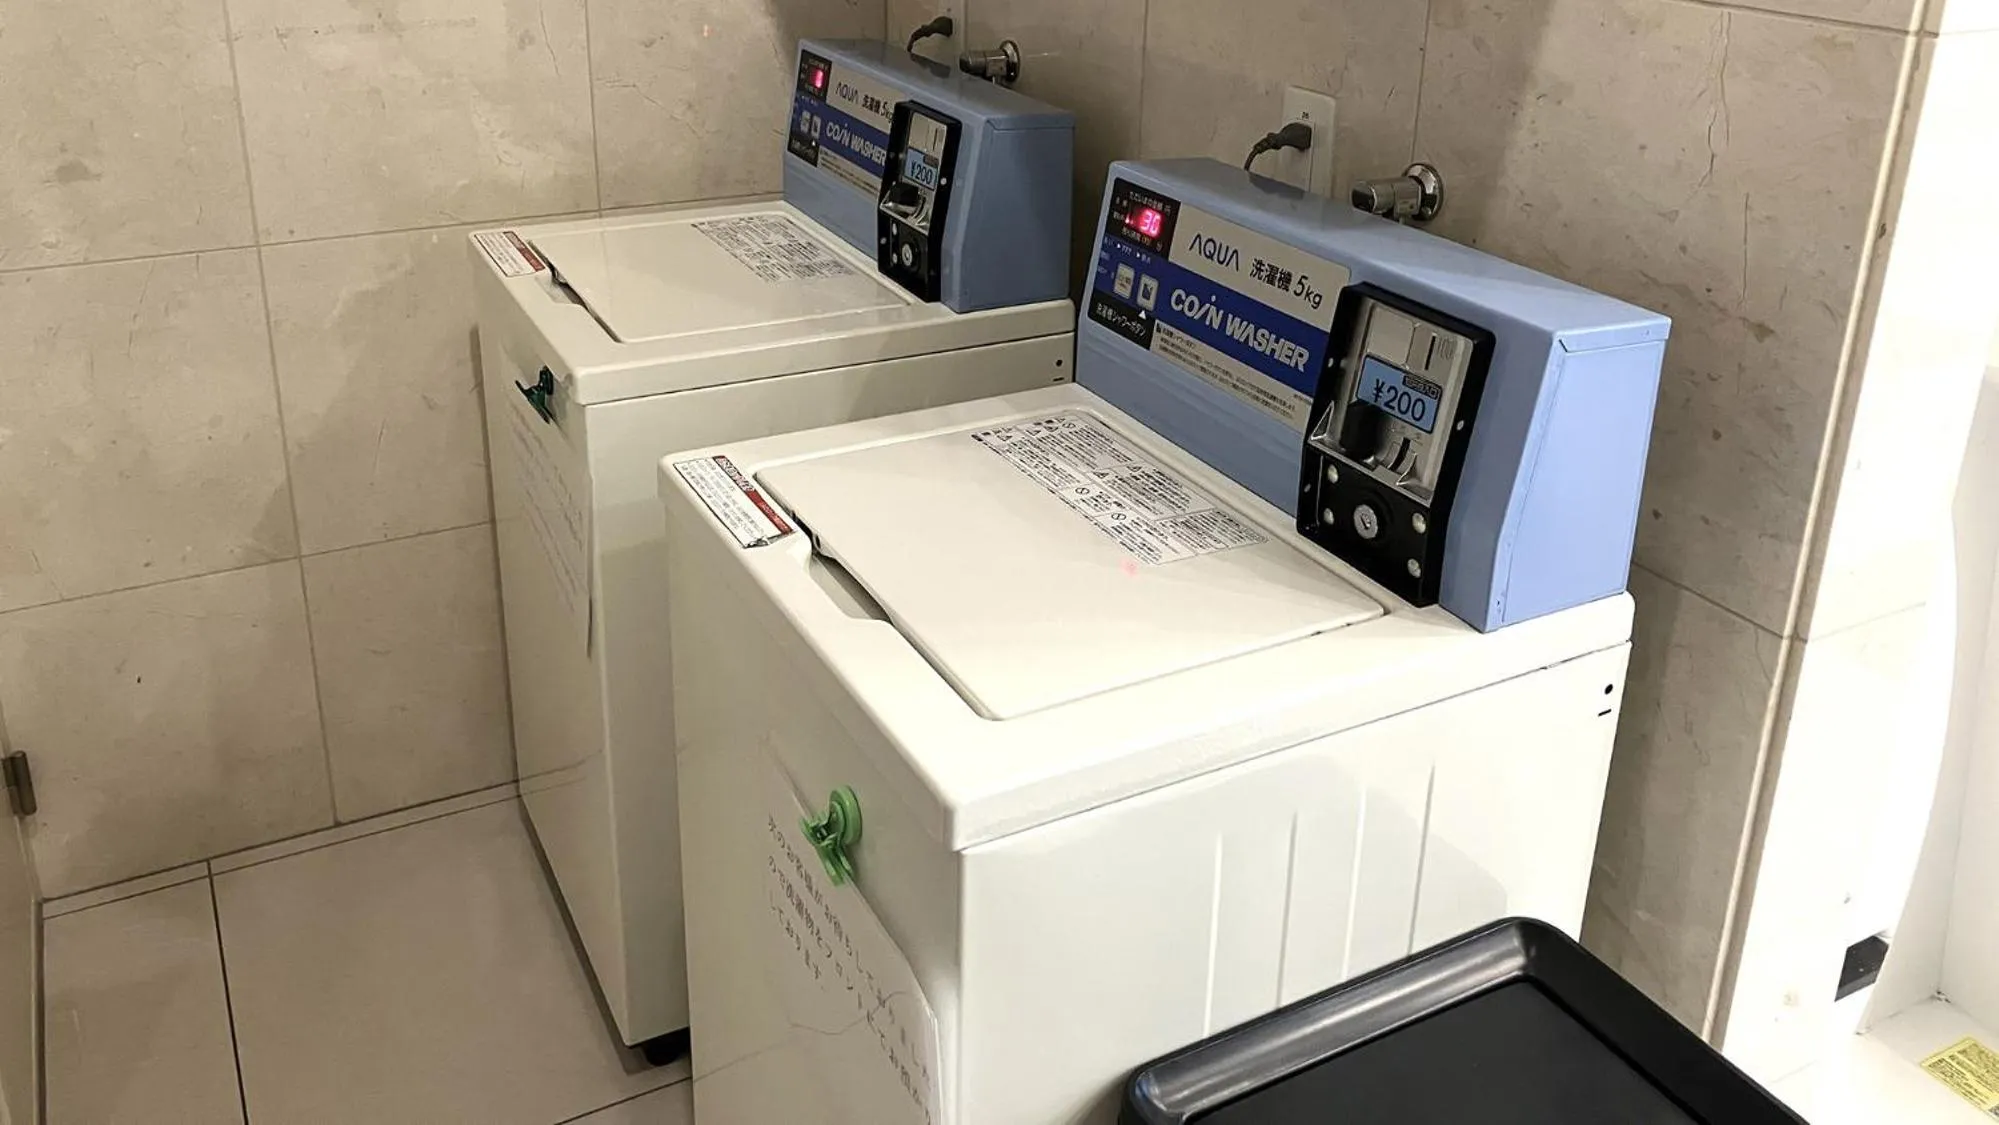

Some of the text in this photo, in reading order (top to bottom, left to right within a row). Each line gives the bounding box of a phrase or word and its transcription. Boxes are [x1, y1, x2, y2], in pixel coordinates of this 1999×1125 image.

[835, 81, 859, 105] AQUA
[826, 121, 851, 147] COIN
[850, 134, 887, 167] WASHER
[911, 160, 933, 185] ¥200
[1139, 208, 1162, 237] 30
[1188, 232, 1241, 272] AQUA
[1249, 257, 1324, 310] 洗濯機 5kg
[1169, 288, 1225, 330] COIN
[1225, 318, 1311, 373] WASHER
[1372, 377, 1426, 423] ¥200
